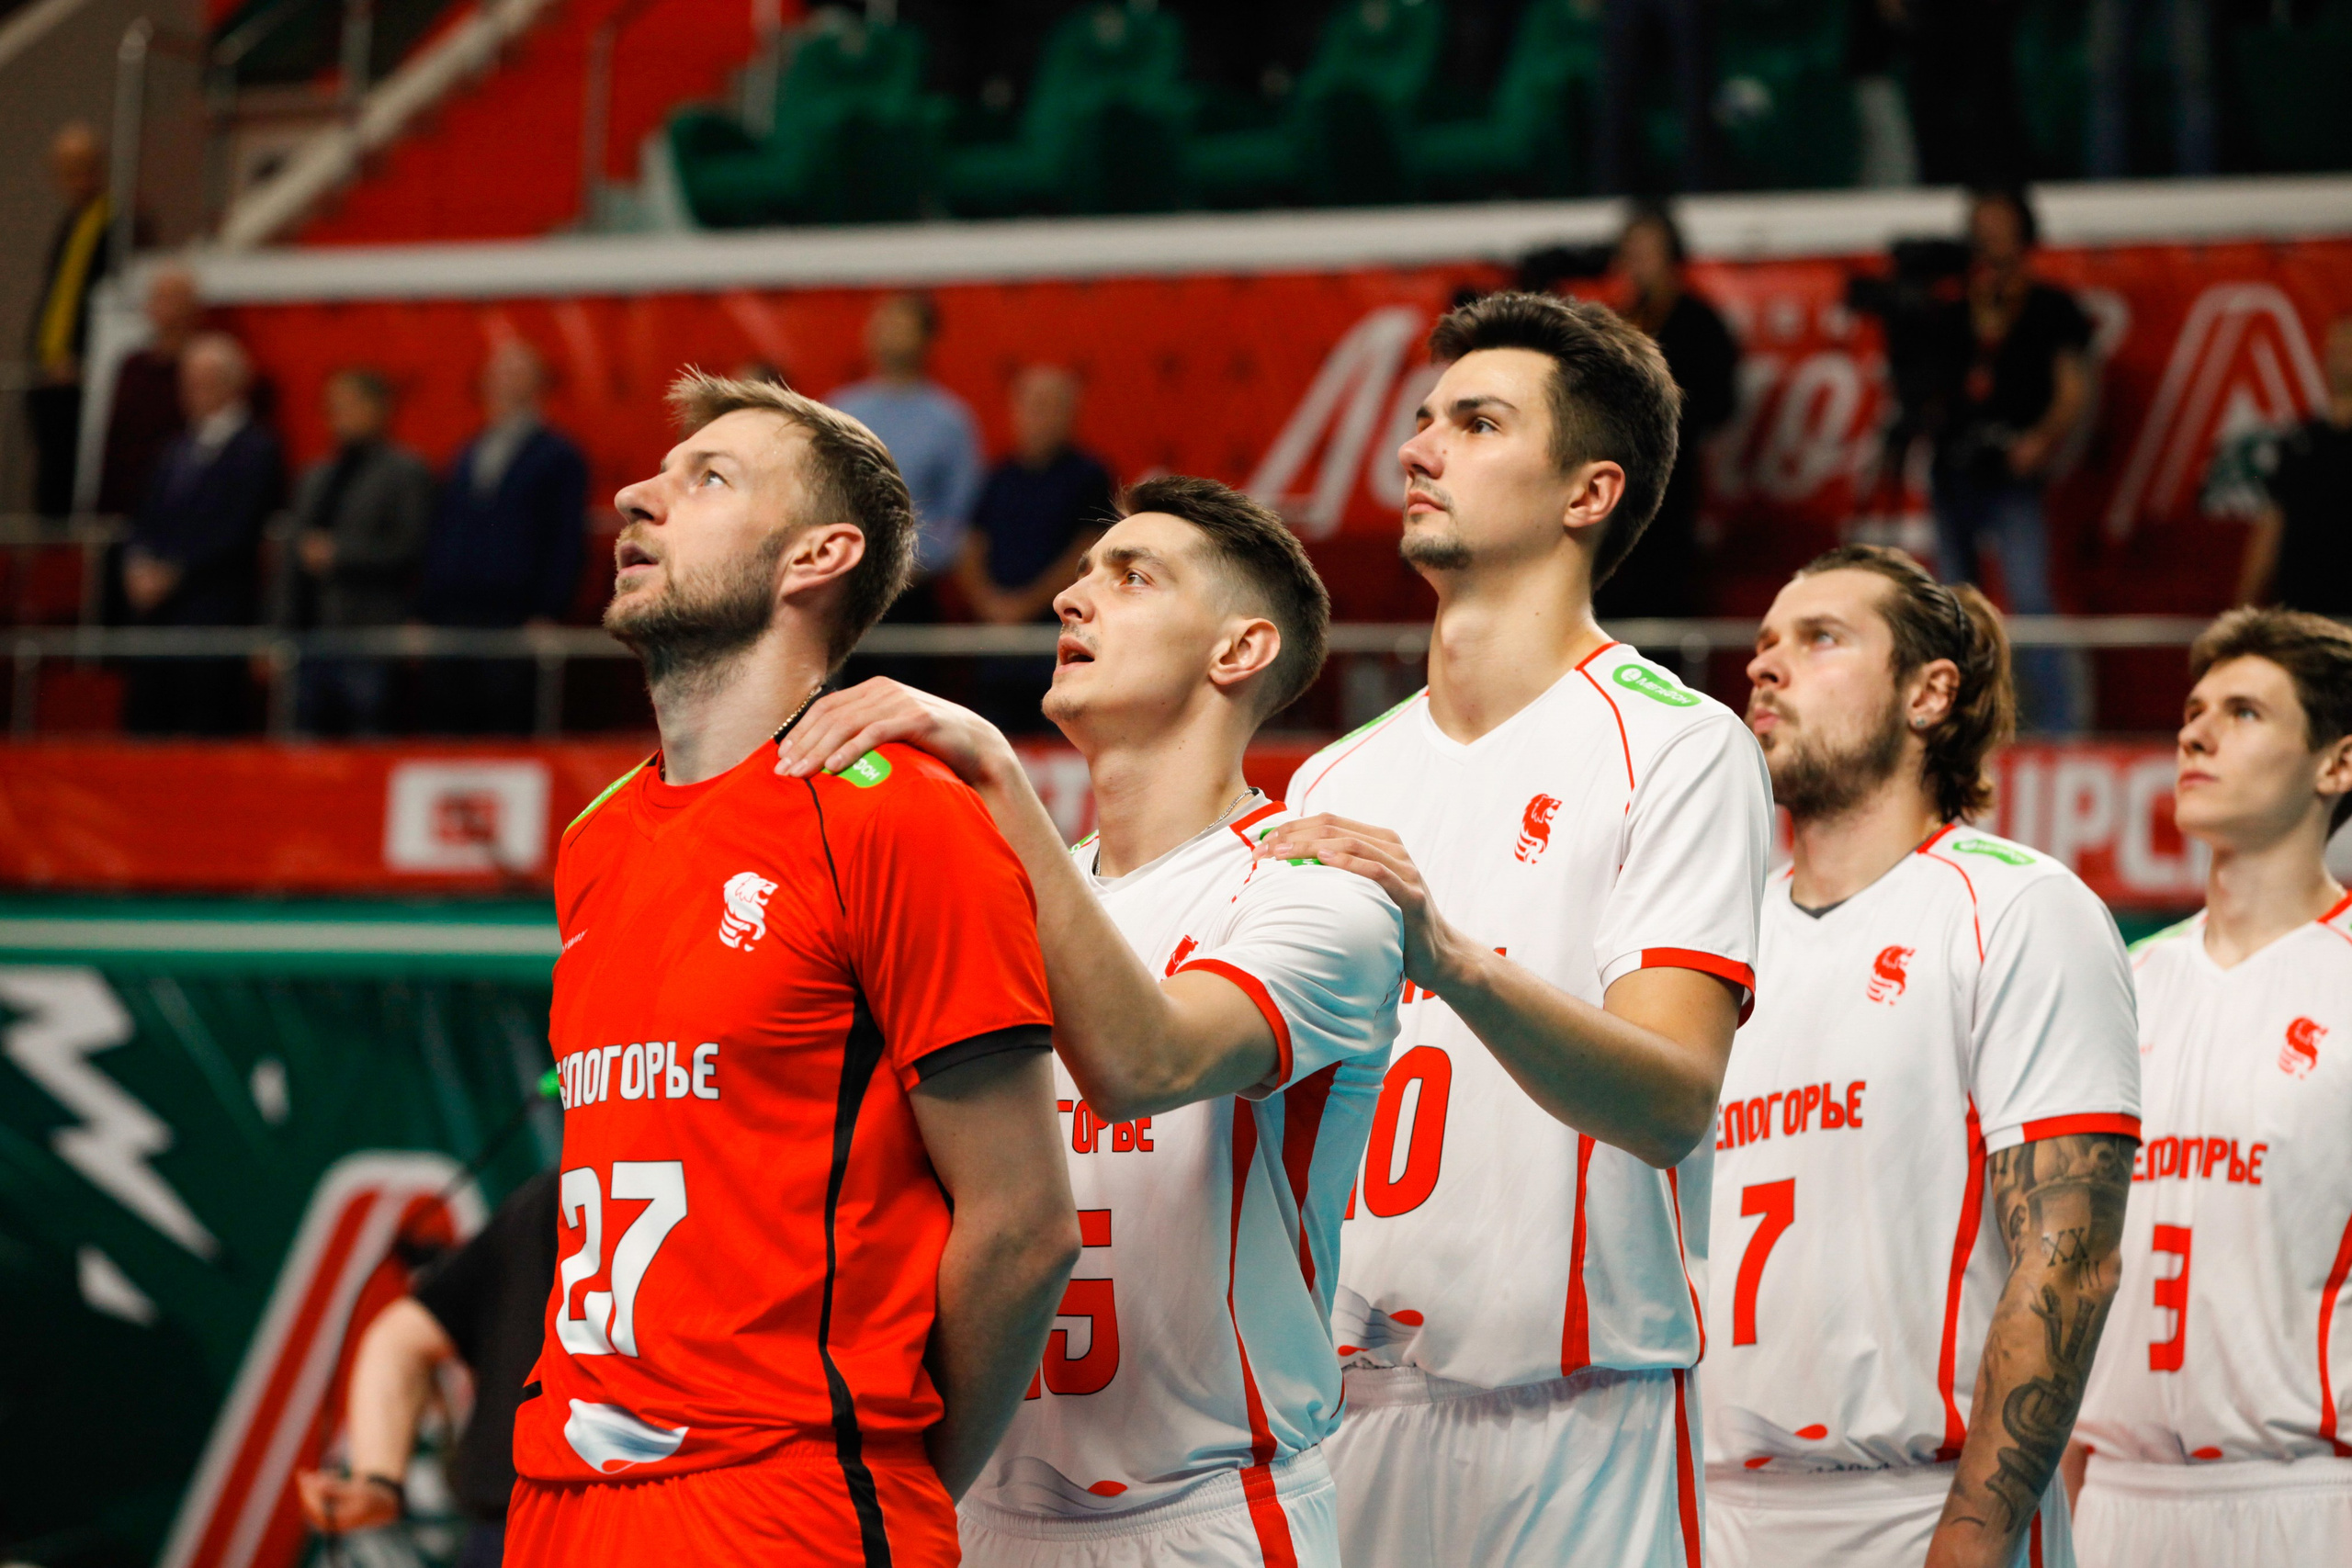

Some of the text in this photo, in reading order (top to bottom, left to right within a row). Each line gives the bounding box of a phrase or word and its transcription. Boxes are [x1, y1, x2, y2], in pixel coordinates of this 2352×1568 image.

[556, 1160, 688, 1358] 27
[1023, 1209, 1120, 1401] 5
[1733, 1177, 1795, 1347] 7
[2149, 1224, 2192, 1371] 3
